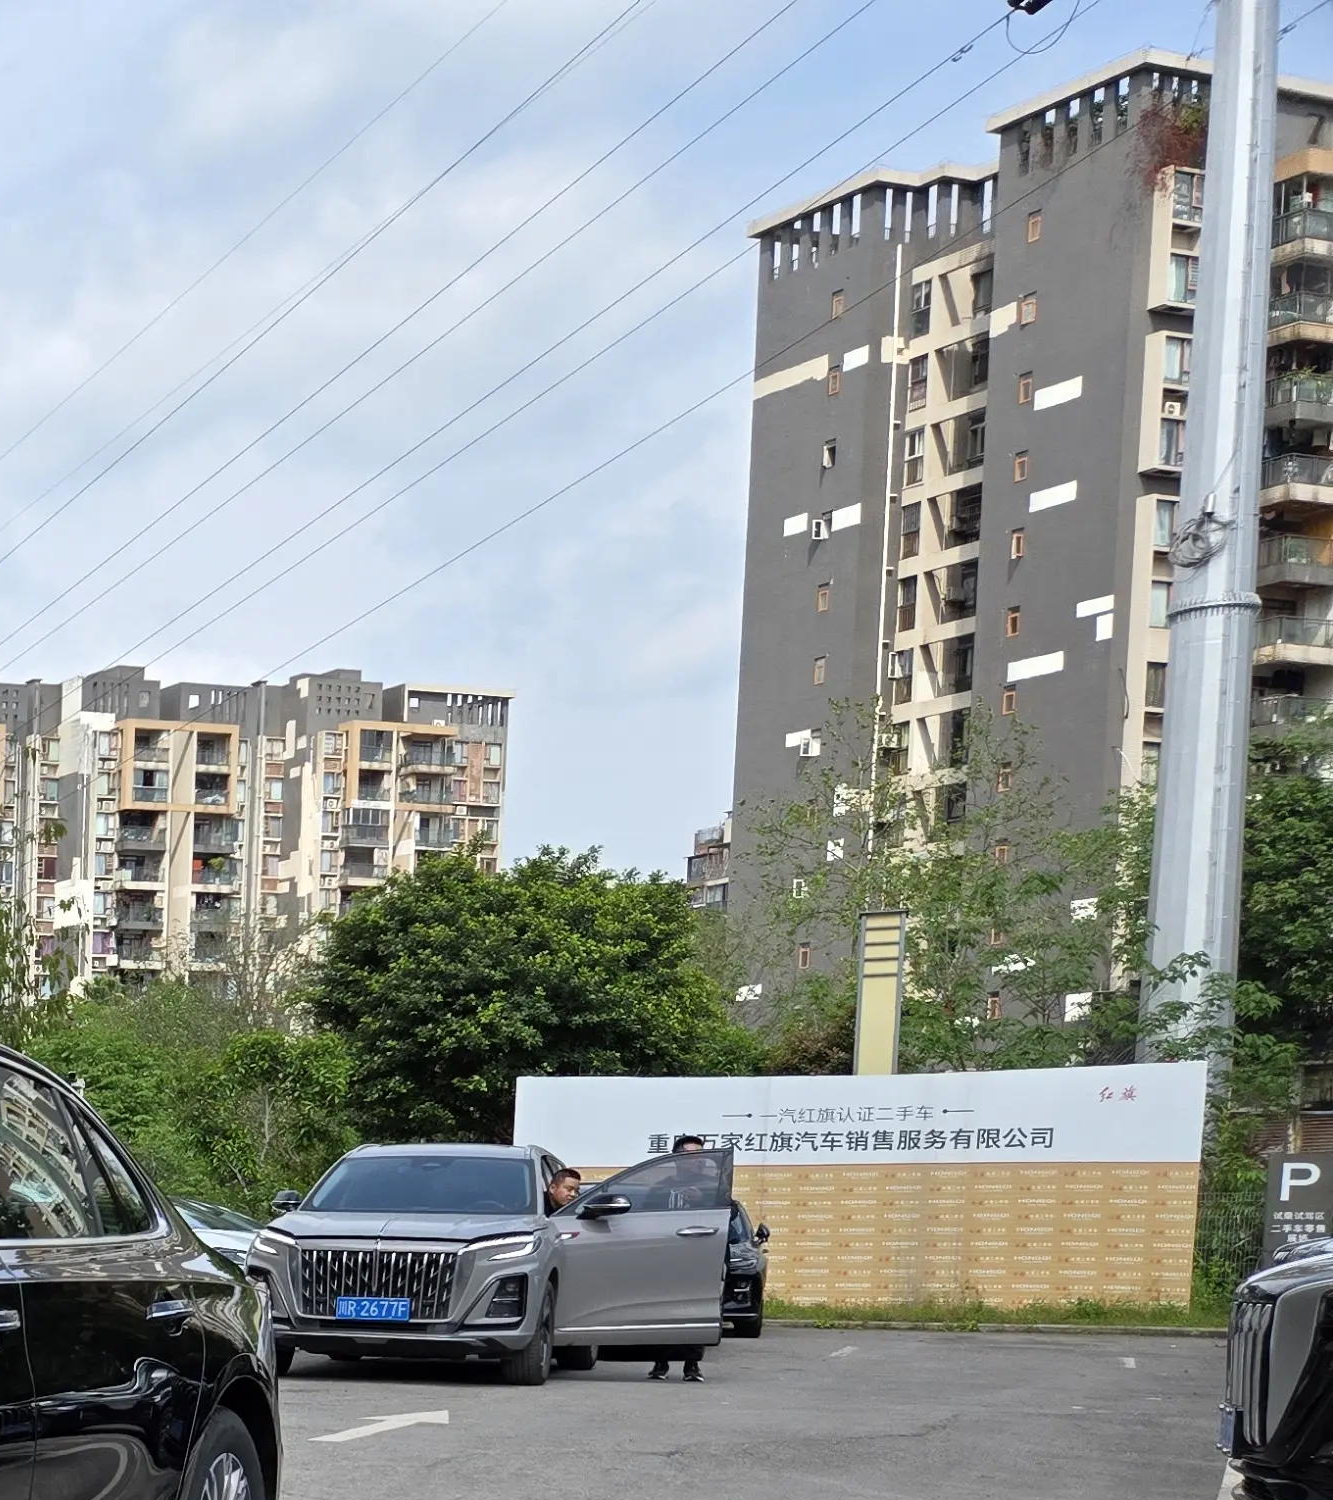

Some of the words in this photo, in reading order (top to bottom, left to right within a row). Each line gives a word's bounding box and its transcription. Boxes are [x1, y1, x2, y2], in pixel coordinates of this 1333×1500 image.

[1098, 1085, 1137, 1103] 红旗
[760, 1105, 935, 1125] 一汽红旗认证二手车
[647, 1126, 1055, 1155] 重万家红旗汽车销售服务有限公司
[1279, 1162, 1321, 1202] P
